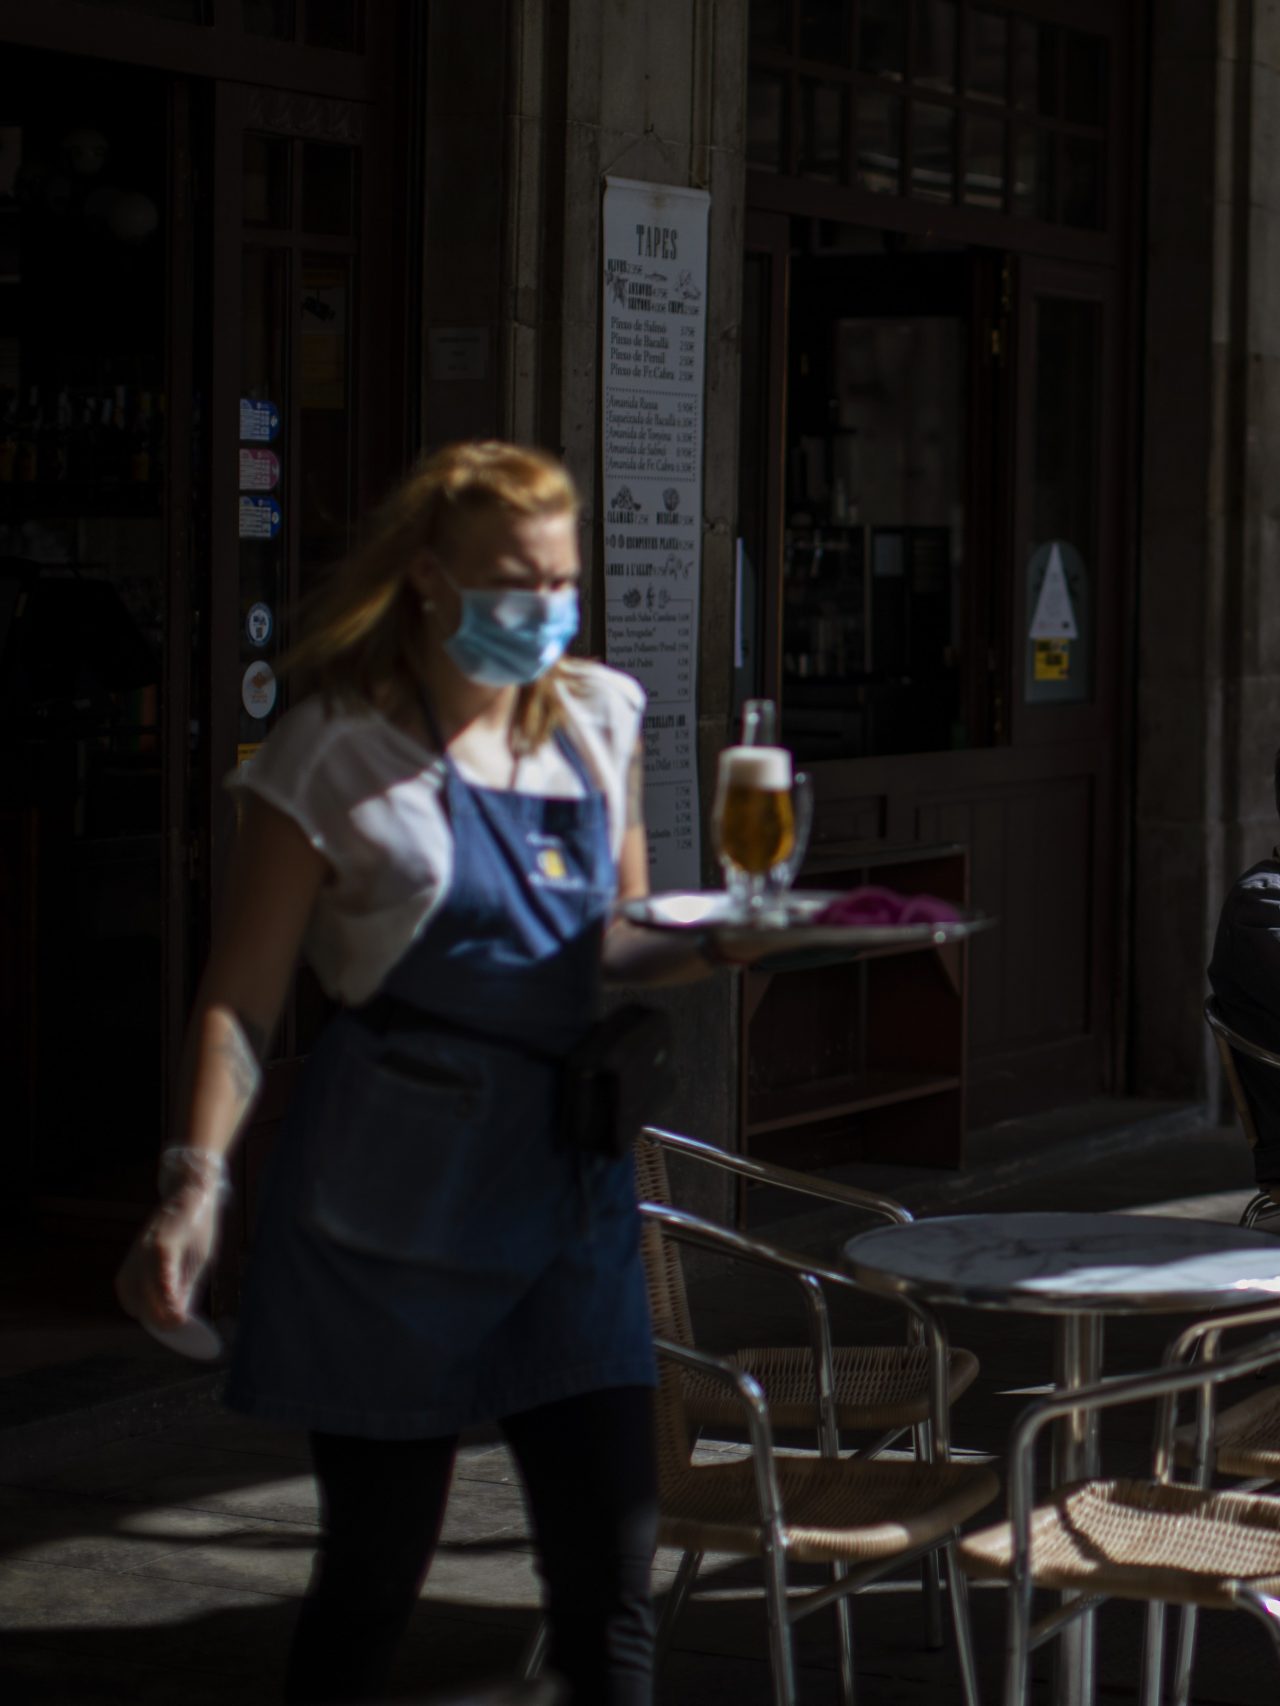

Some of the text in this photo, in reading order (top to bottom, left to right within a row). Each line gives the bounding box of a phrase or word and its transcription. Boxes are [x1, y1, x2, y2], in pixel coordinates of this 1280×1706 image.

[636, 224, 678, 260] TAPES
[611, 316, 632, 330] Pinxo
[634, 319, 642, 331] de
[611, 331, 632, 345] Pinxo
[634, 334, 642, 347] de
[611, 347, 632, 361] Pinxo
[633, 349, 642, 362] de
[644, 350, 665, 364] Pernil
[610, 362, 631, 377] Pinxo
[633, 365, 641, 378] de
[608, 395, 638, 409] Amanida
[646, 412, 653, 425] de
[608, 426, 637, 439] Amanida
[638, 426, 647, 440] de
[608, 441, 637, 455] Amanida
[638, 441, 646, 455] de
[608, 456, 636, 470] Amanida
[638, 456, 645, 471] de
